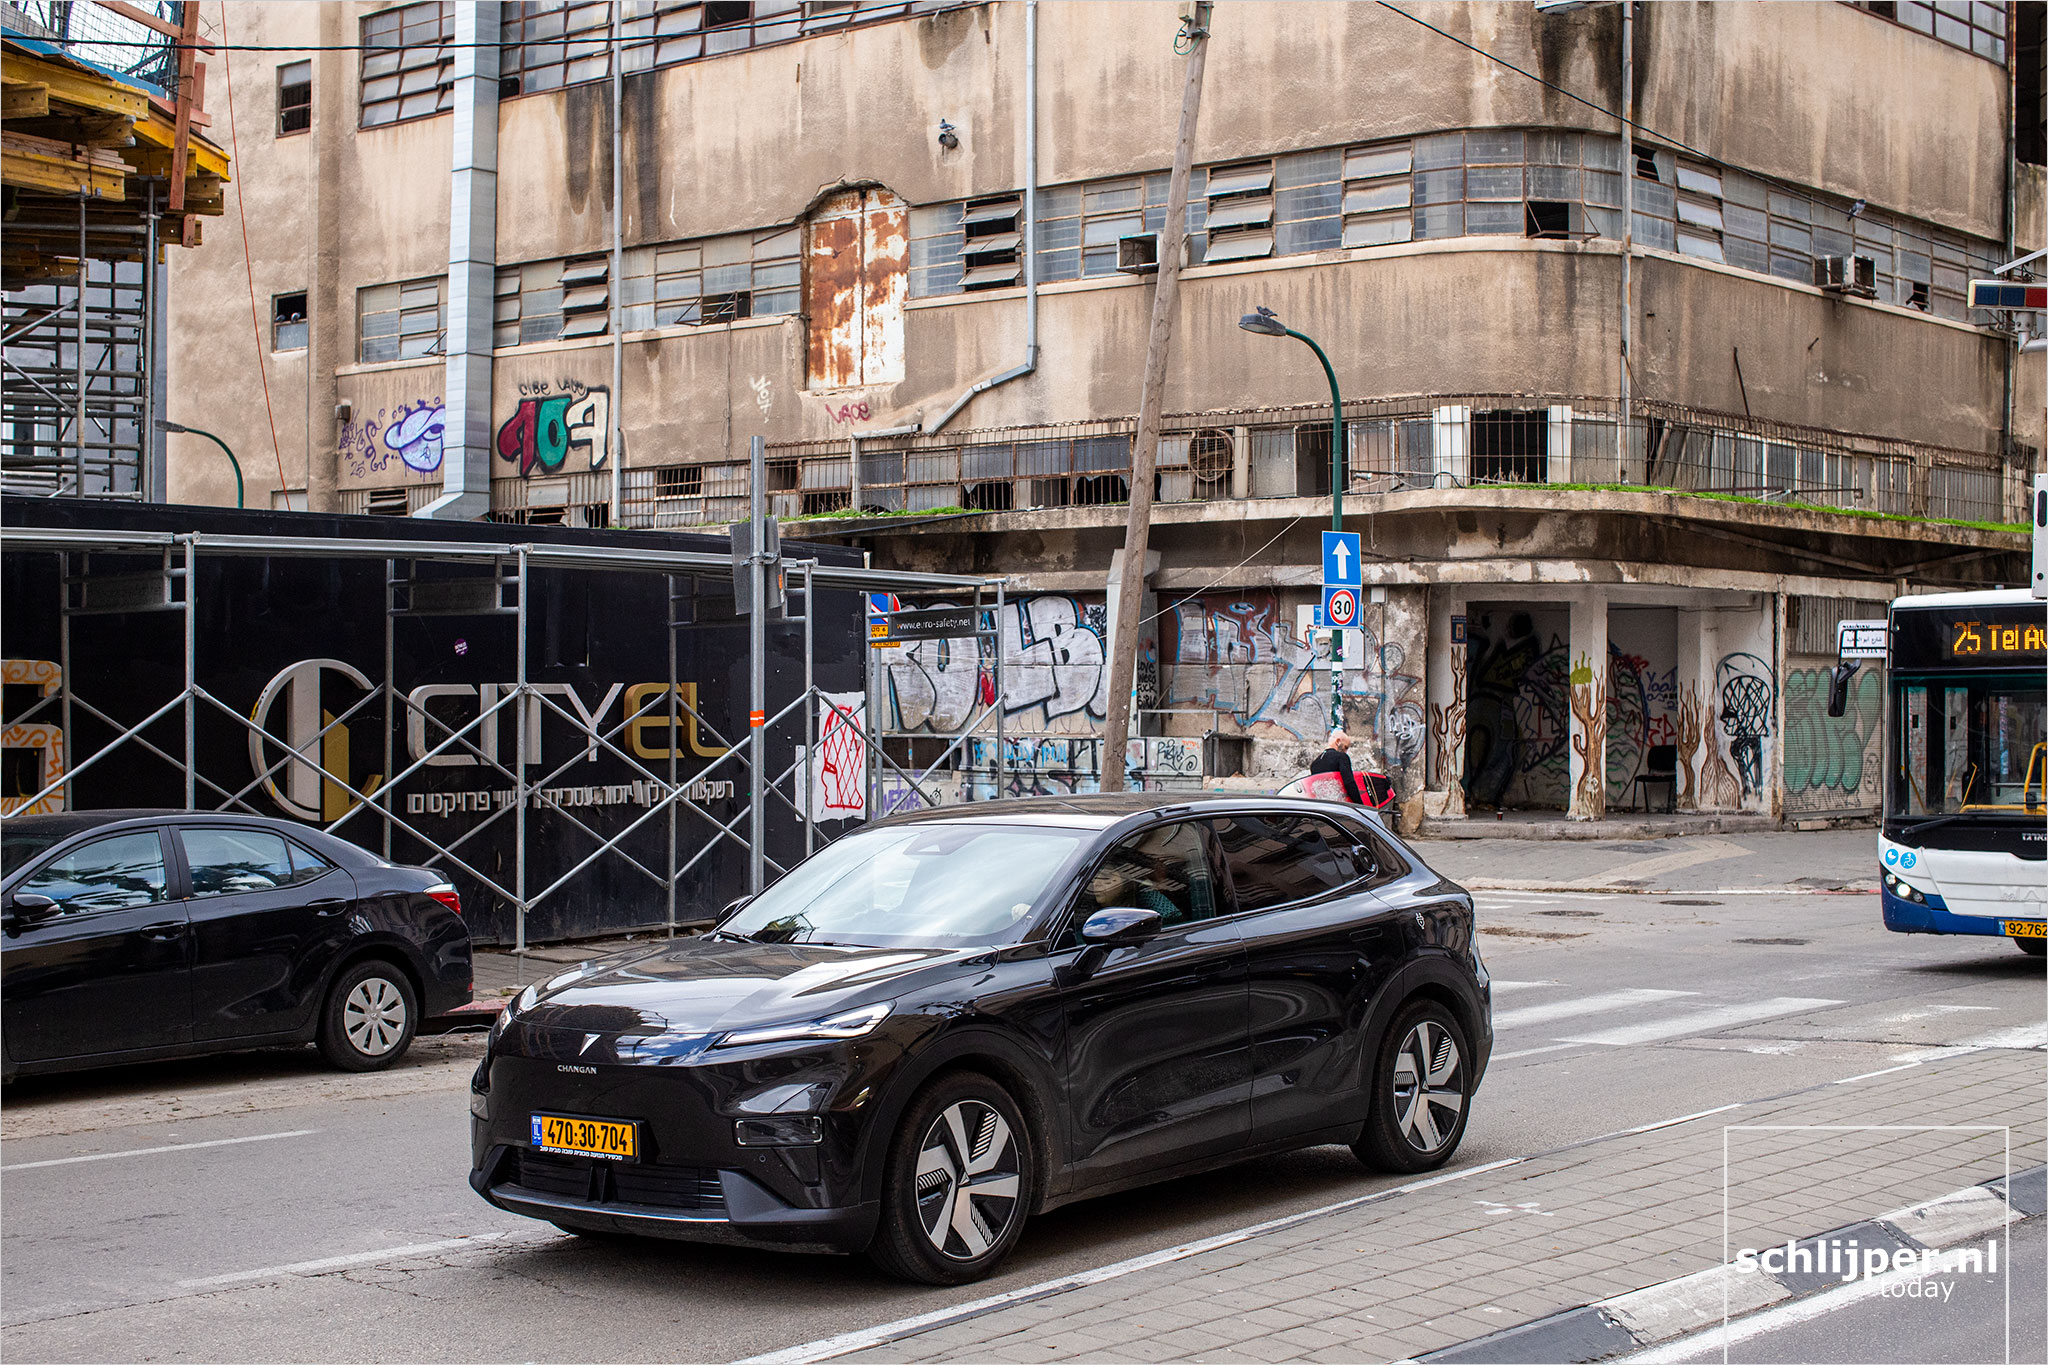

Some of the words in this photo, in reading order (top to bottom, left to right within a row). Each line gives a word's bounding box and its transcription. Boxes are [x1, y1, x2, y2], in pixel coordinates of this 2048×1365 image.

[1333, 600, 1352, 616] 30
[896, 617, 972, 631] www.euro-safety.net
[1954, 622, 1981, 655] 25
[1988, 624, 2019, 651] Tel
[557, 1064, 597, 1075] CHANGAN
